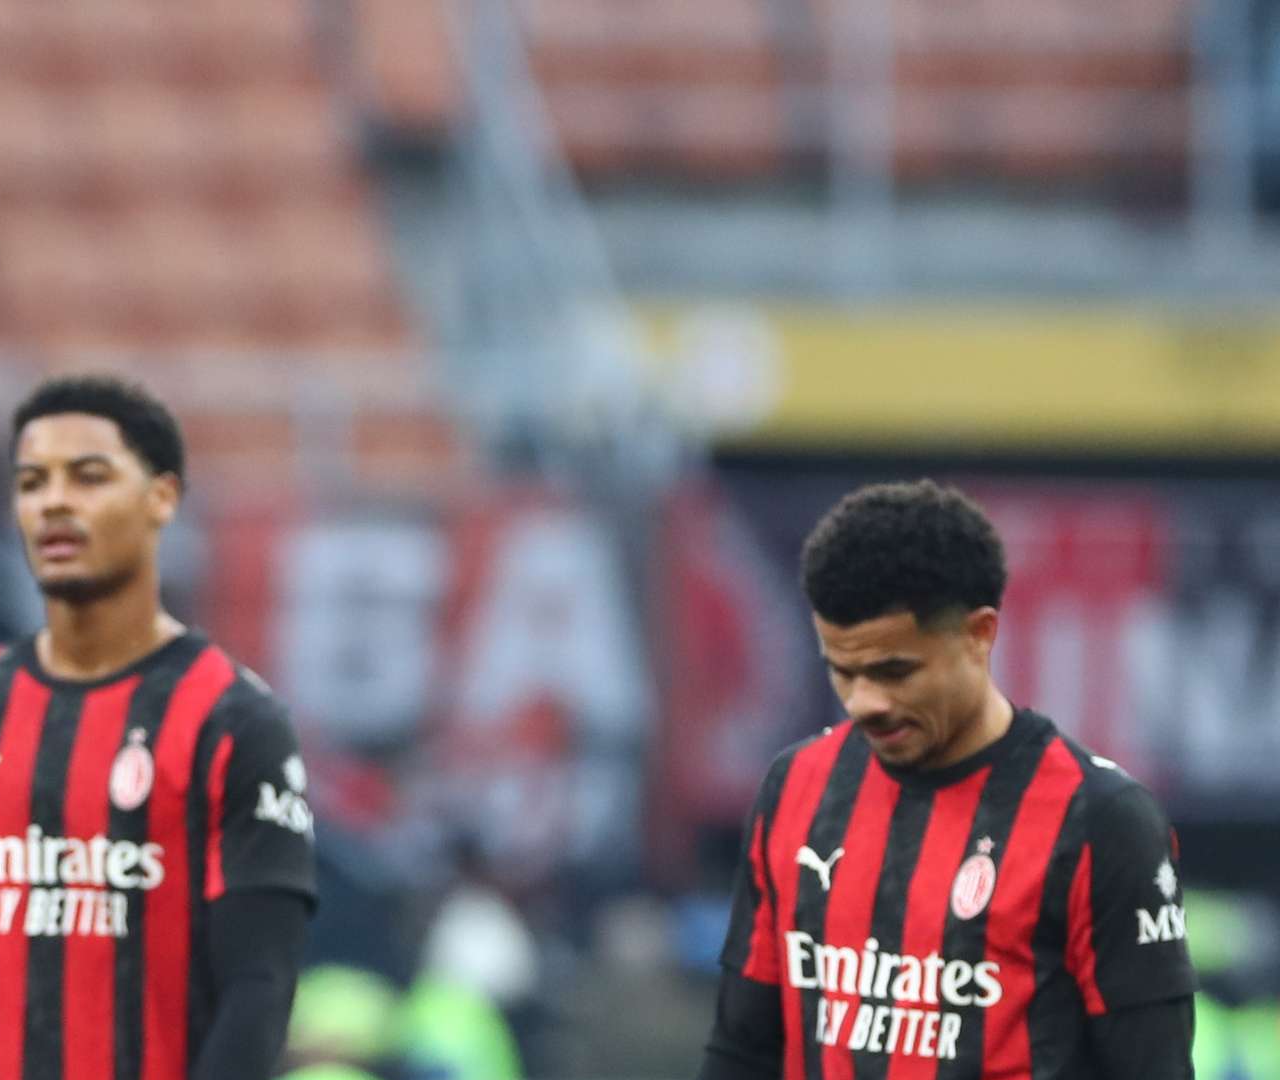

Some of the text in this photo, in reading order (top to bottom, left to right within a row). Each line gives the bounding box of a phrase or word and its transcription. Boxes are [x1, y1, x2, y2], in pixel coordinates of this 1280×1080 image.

[24, 886, 129, 938] BETTER
[785, 930, 1003, 1007] Emirates
[848, 1003, 962, 1060] BETTER
